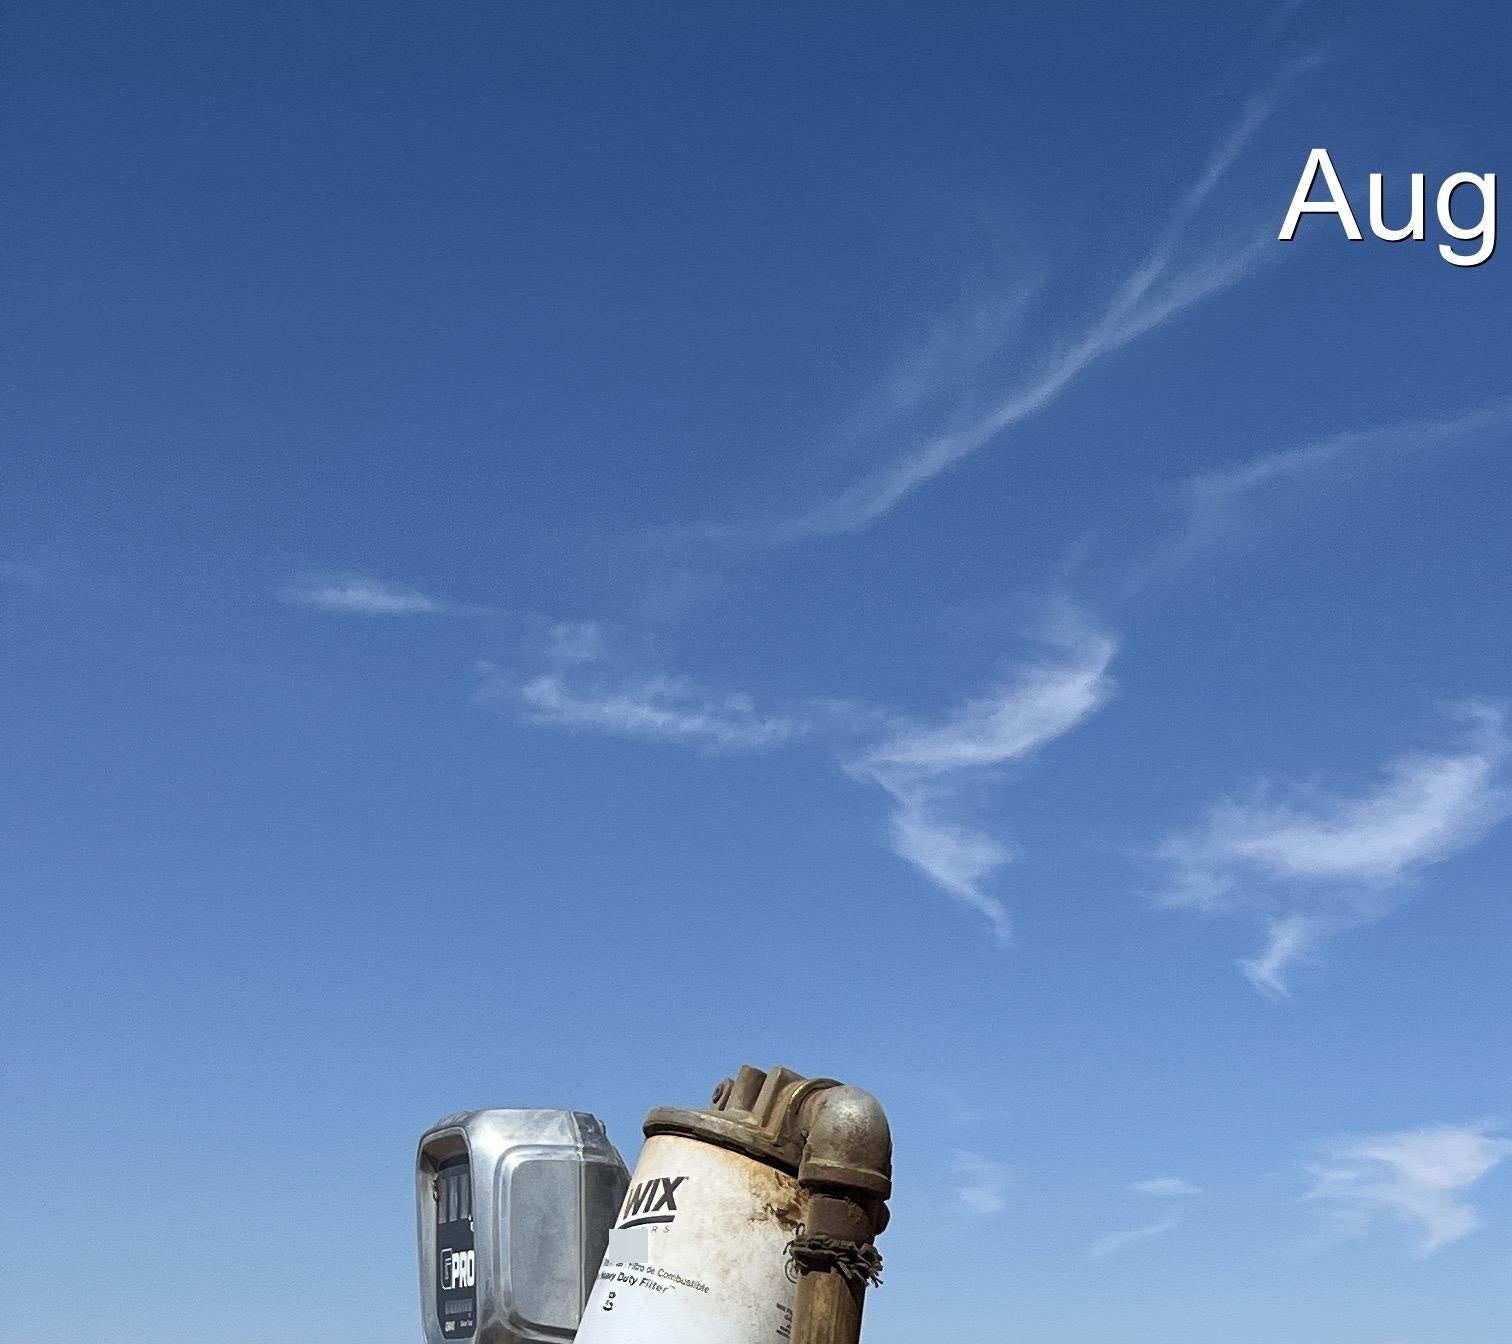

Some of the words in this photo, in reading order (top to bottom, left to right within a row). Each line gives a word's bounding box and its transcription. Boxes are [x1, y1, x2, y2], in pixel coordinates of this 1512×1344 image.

[623, 1177, 685, 1220] WIX
[617, 1272, 638, 1286] Duty
[639, 1277, 670, 1293] Filter
[657, 1268, 710, 1293] Combustible
